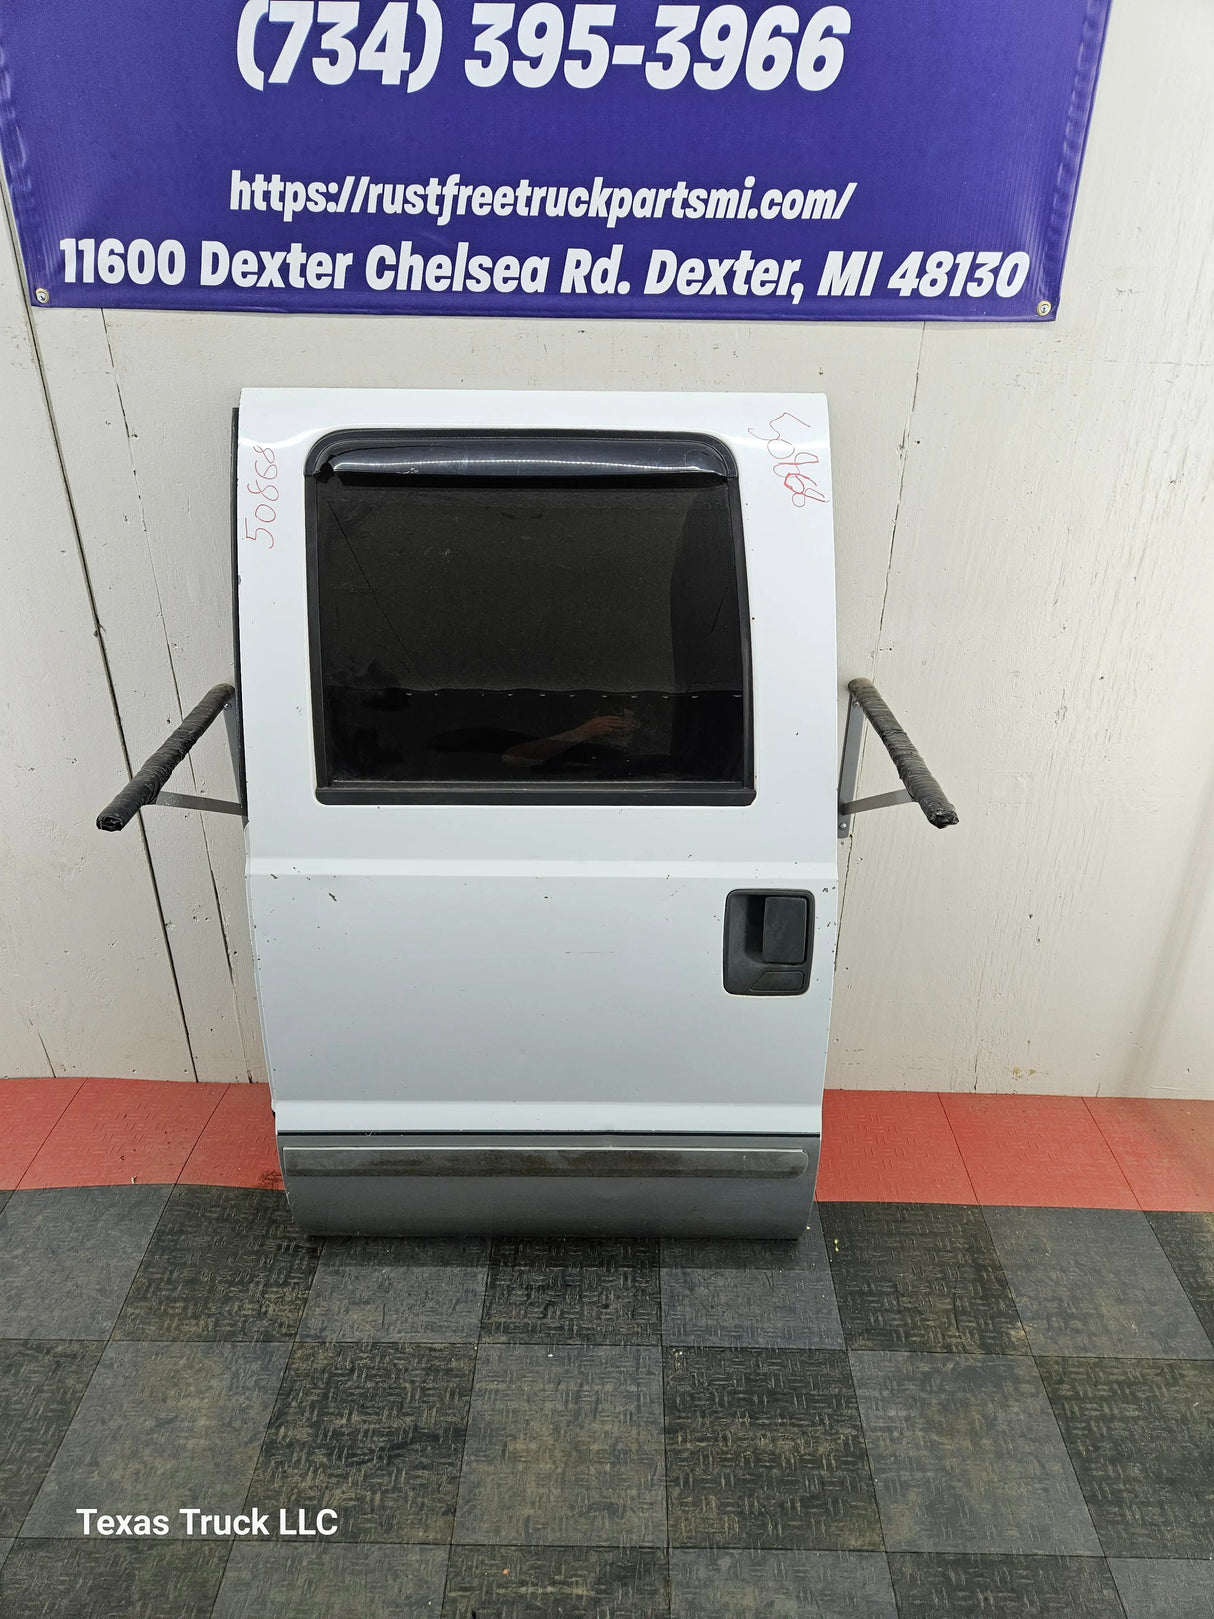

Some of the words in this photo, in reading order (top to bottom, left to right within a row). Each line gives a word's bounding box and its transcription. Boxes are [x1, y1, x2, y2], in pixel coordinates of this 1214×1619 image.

[237, 0, 443, 93] (734)
[465, 3, 851, 91] 395-3966
[229, 170, 858, 228] https://rustfreetruckpartsmi.com/
[60, 238, 186, 286] 11600
[200, 240, 354, 290] Dexter
[366, 240, 551, 294] Chelsea
[560, 244, 631, 295] Rd.
[644, 249, 804, 305] Dexter,
[817, 250, 884, 297] MI
[888, 250, 1031, 298] 48130
